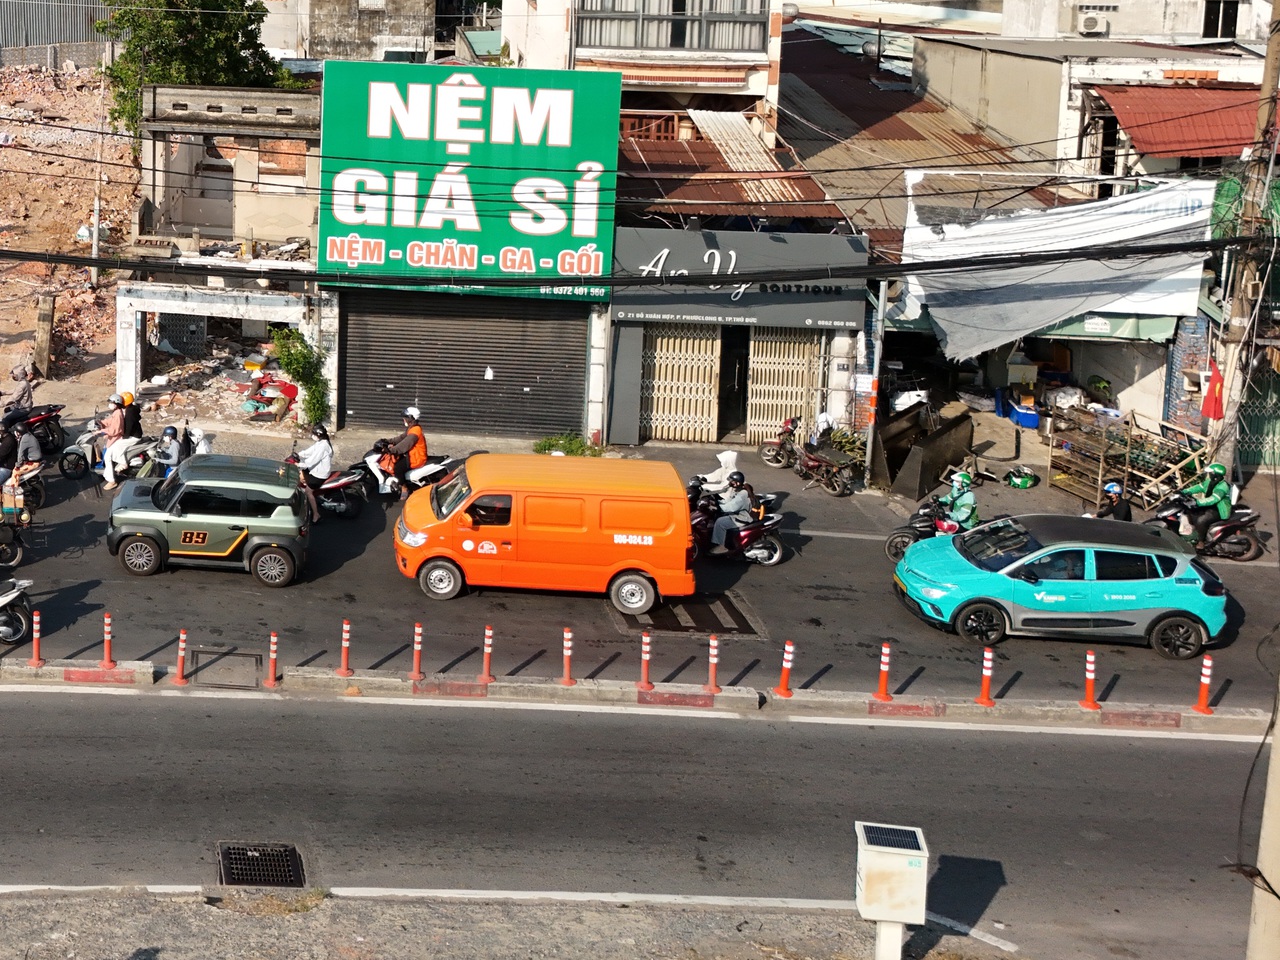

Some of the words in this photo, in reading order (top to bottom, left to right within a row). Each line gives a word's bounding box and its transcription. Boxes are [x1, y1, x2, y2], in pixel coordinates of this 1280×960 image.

[366, 72, 575, 154] NỆM
[331, 161, 482, 233] GIÁ
[509, 160, 606, 239] SỈ
[326, 233, 387, 268] NỆM
[406, 236, 479, 271] CHĂN
[498, 246, 537, 274] GA
[557, 243, 605, 277] GỐI
[759, 283, 843, 295] BOUTIQUE
[181, 530, 208, 545] 89
